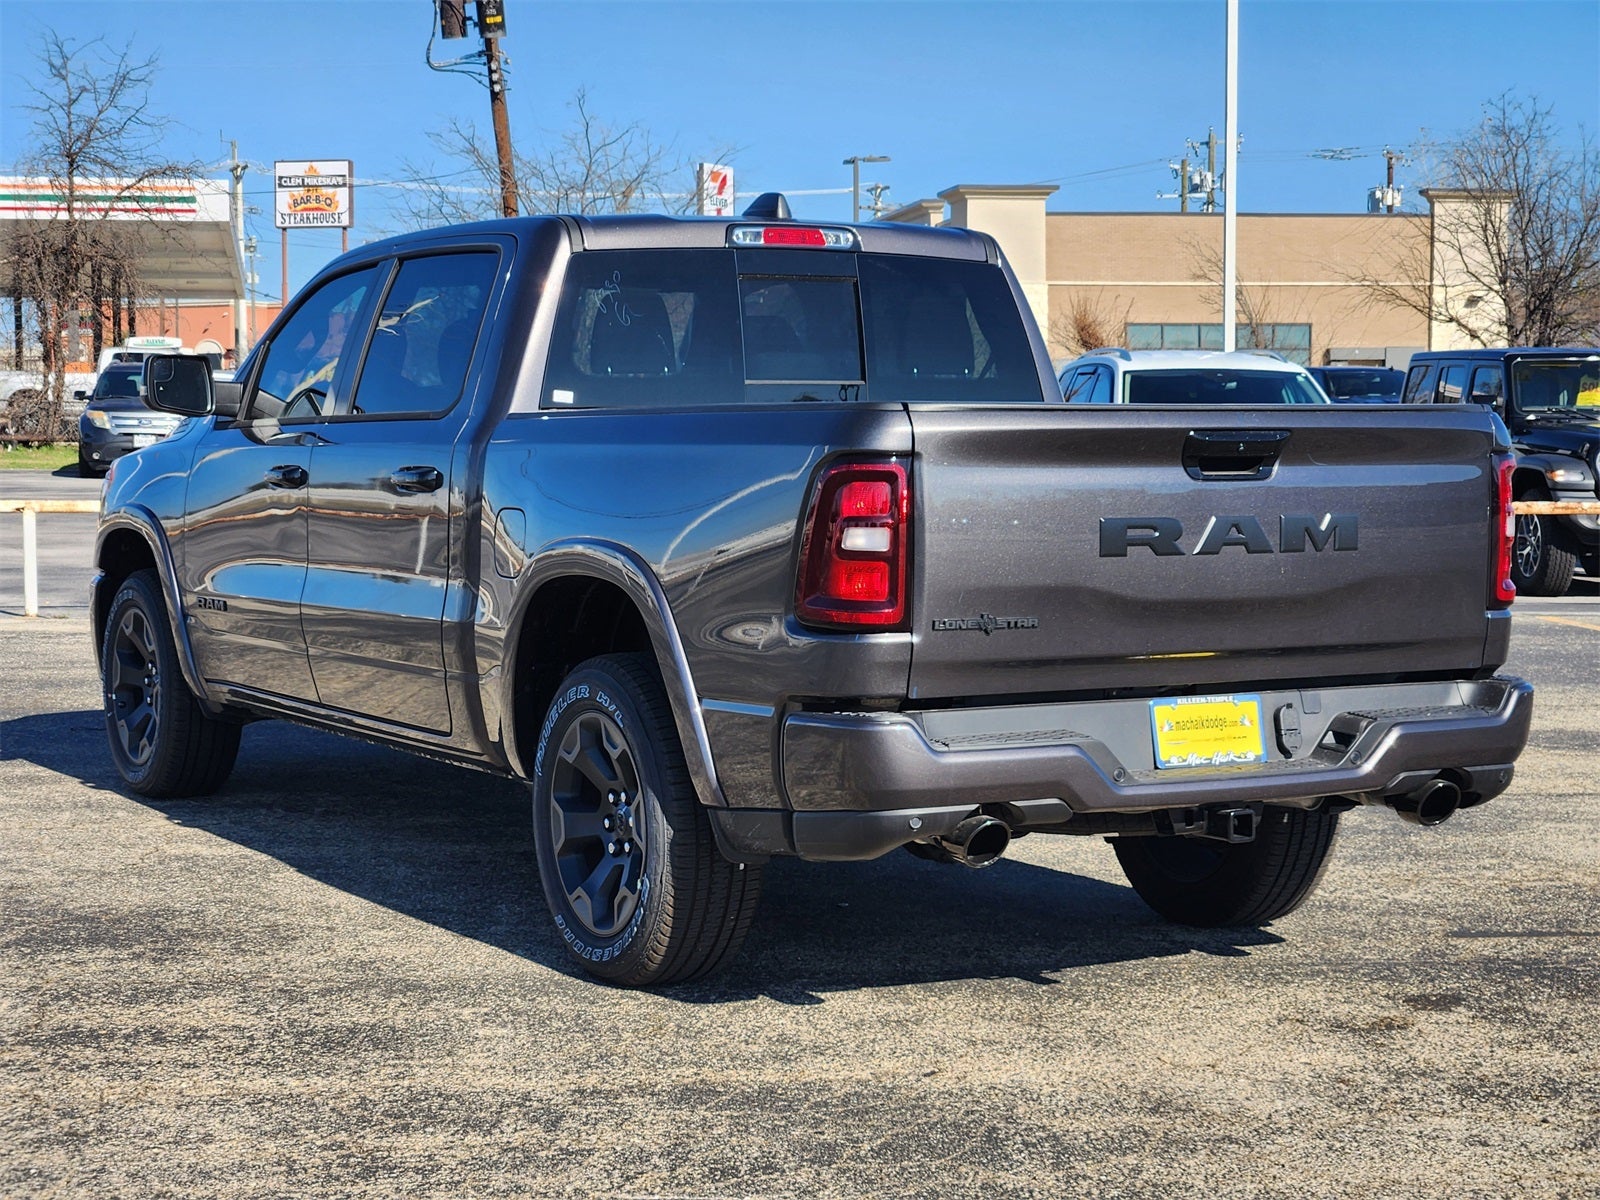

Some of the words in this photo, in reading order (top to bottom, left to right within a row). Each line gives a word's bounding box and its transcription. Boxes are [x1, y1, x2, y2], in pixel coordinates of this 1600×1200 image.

[281, 177, 302, 186] CLEM
[304, 176, 344, 186] MIKESKA'S
[292, 195, 333, 209] BAR-B-Q
[280, 212, 343, 225] STEAKHOUSE
[1100, 514, 1358, 557] RAM
[197, 596, 228, 611] RAM
[932, 618, 981, 631] LONE
[995, 617, 1040, 630] STAR
[1177, 696, 1234, 705] KILLEEN-TEMPLE
[1175, 715, 1238, 732] machaikdodge.com
